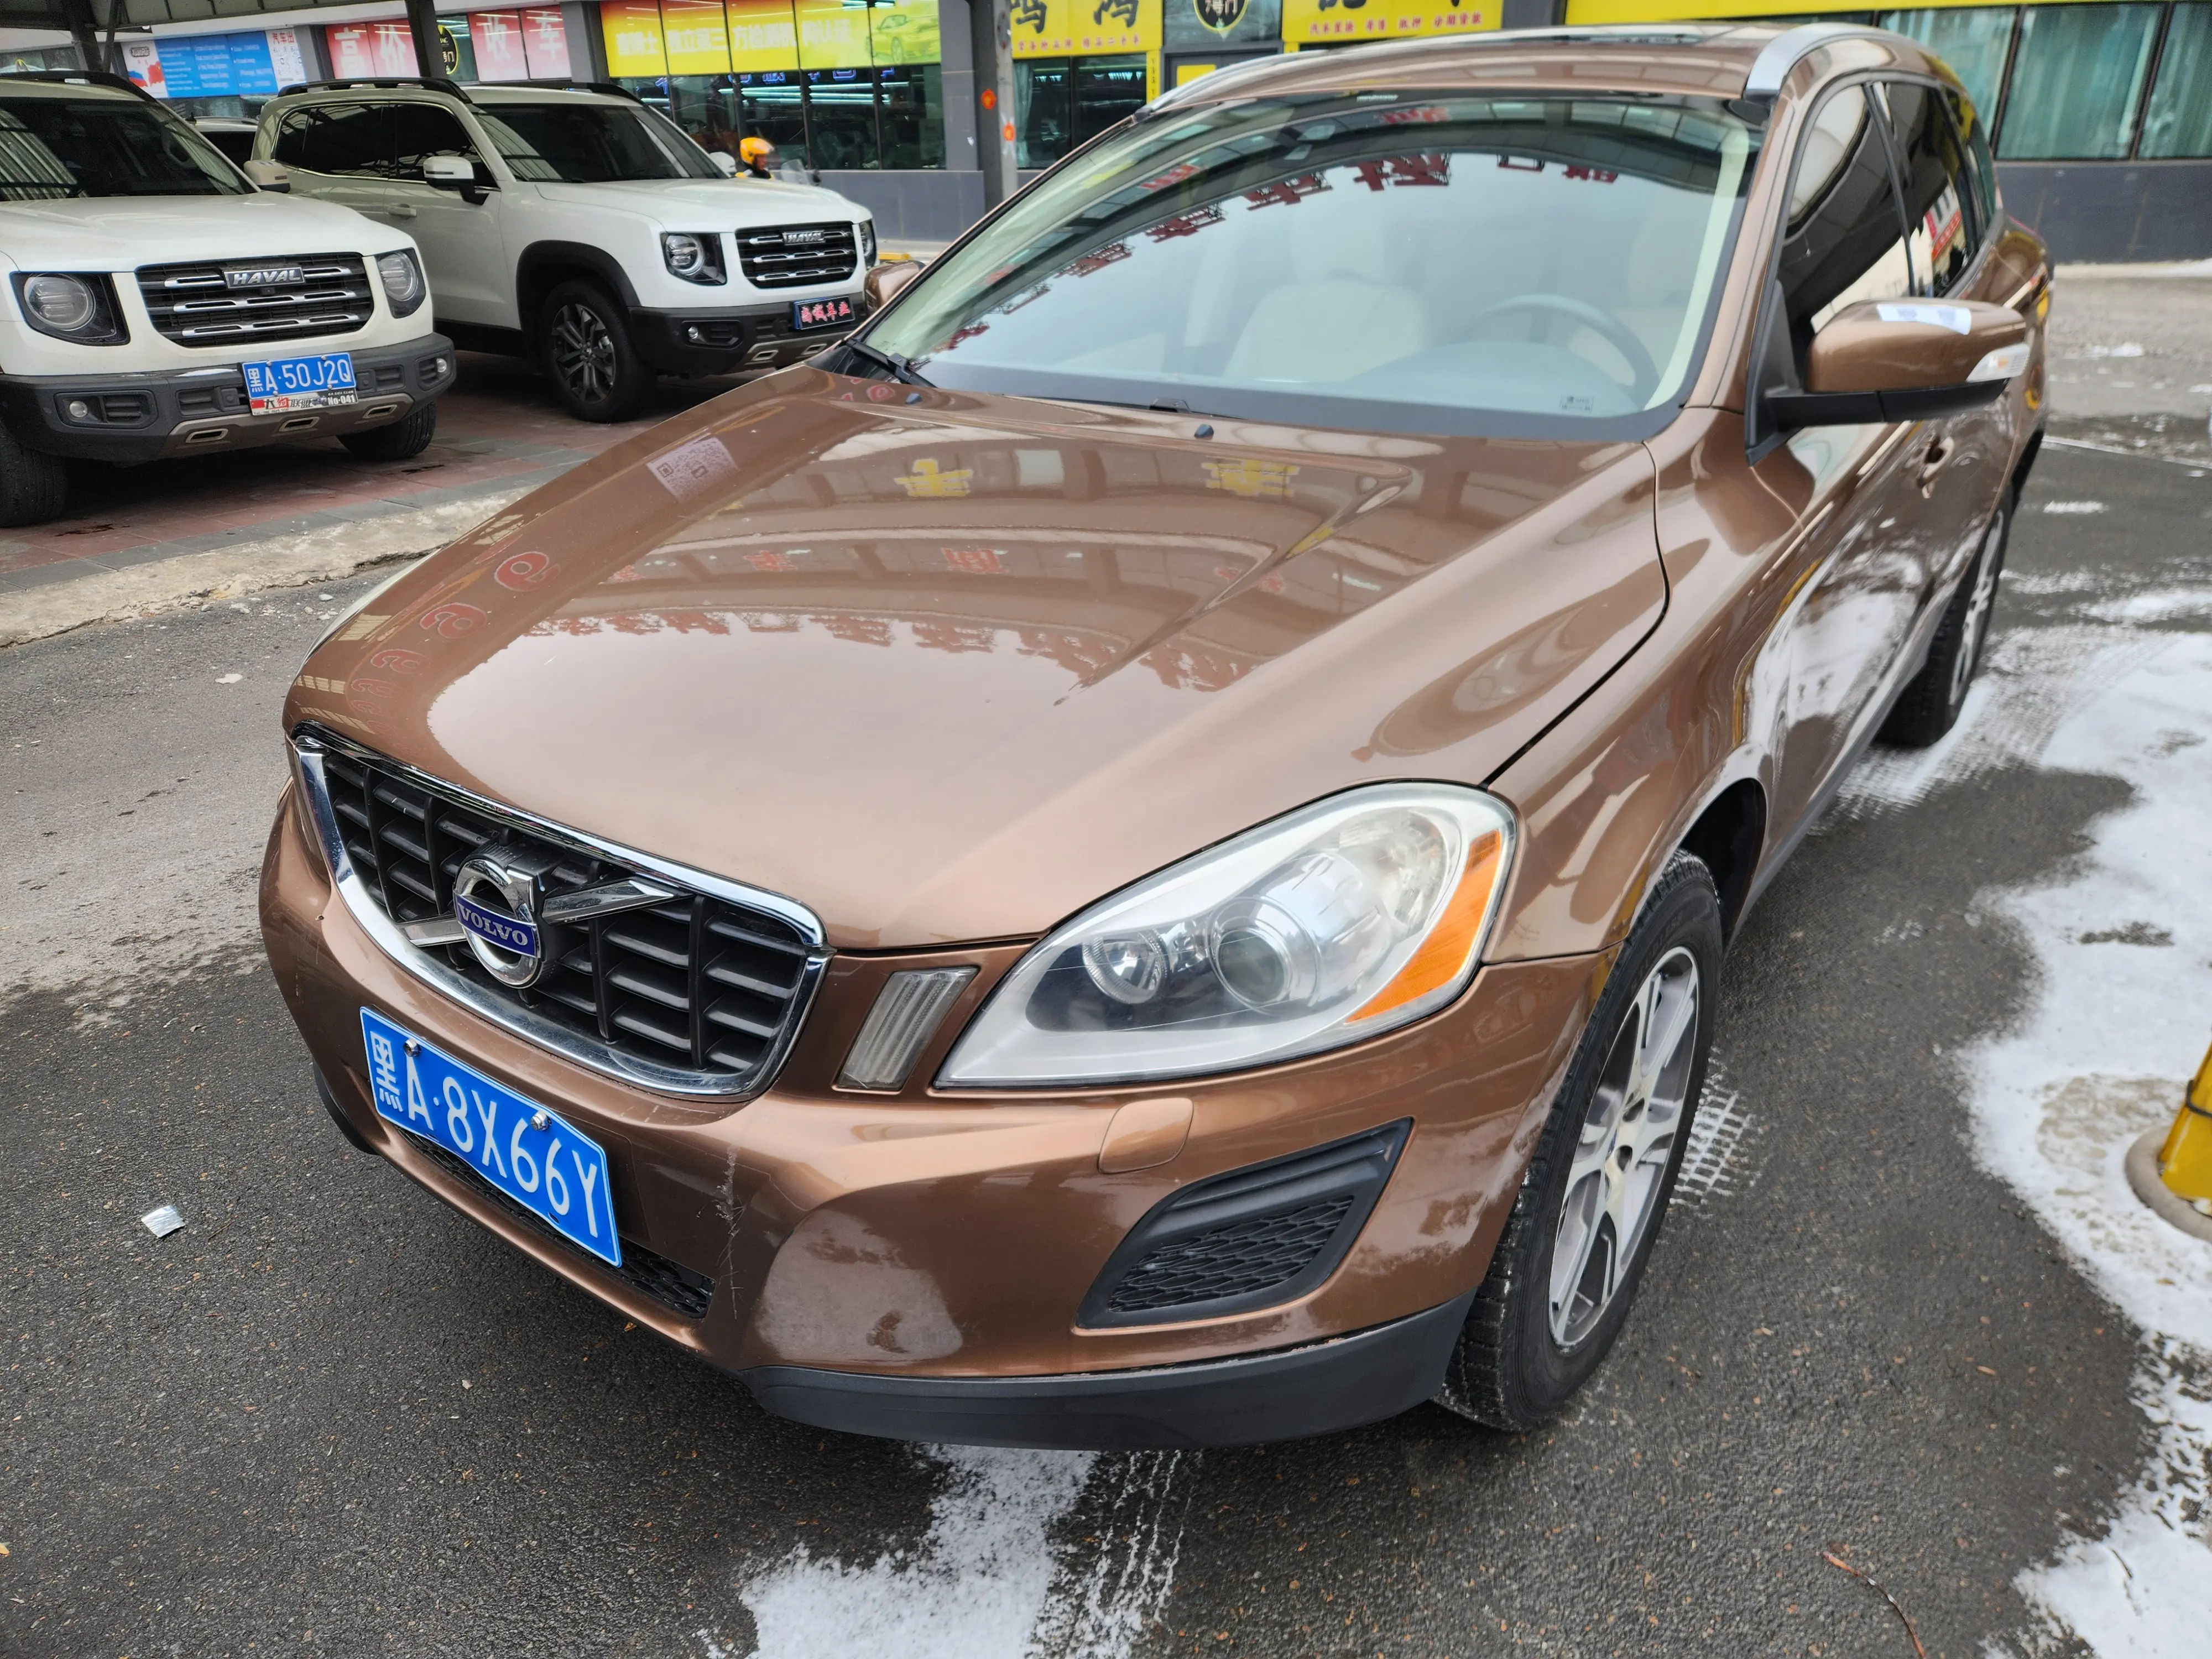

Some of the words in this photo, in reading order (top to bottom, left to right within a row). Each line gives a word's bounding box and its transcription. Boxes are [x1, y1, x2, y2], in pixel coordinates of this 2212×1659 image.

[787, 232, 824, 242] HAVAL
[233, 269, 301, 286] HAVAL
[264, 397, 313, 410] 大狗联盟
[457, 905, 529, 947] VOLVO
